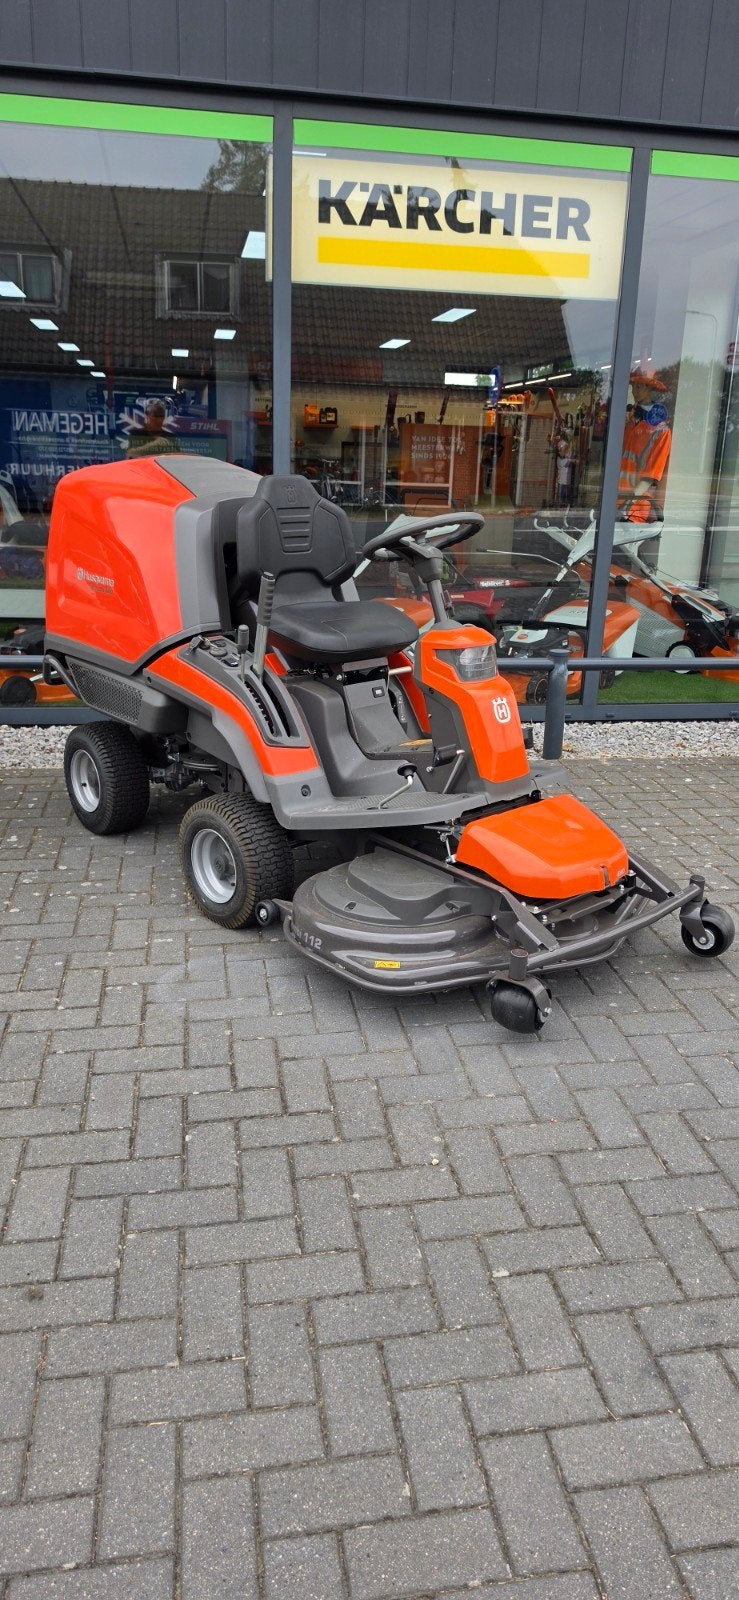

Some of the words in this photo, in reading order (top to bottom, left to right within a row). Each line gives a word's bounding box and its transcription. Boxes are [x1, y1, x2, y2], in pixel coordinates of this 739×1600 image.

[317, 178, 592, 243] KÄRCHER
[189, 421, 221, 431] STIHL
[428, 435, 446, 443] IDEE
[303, 932, 322, 950] 112
